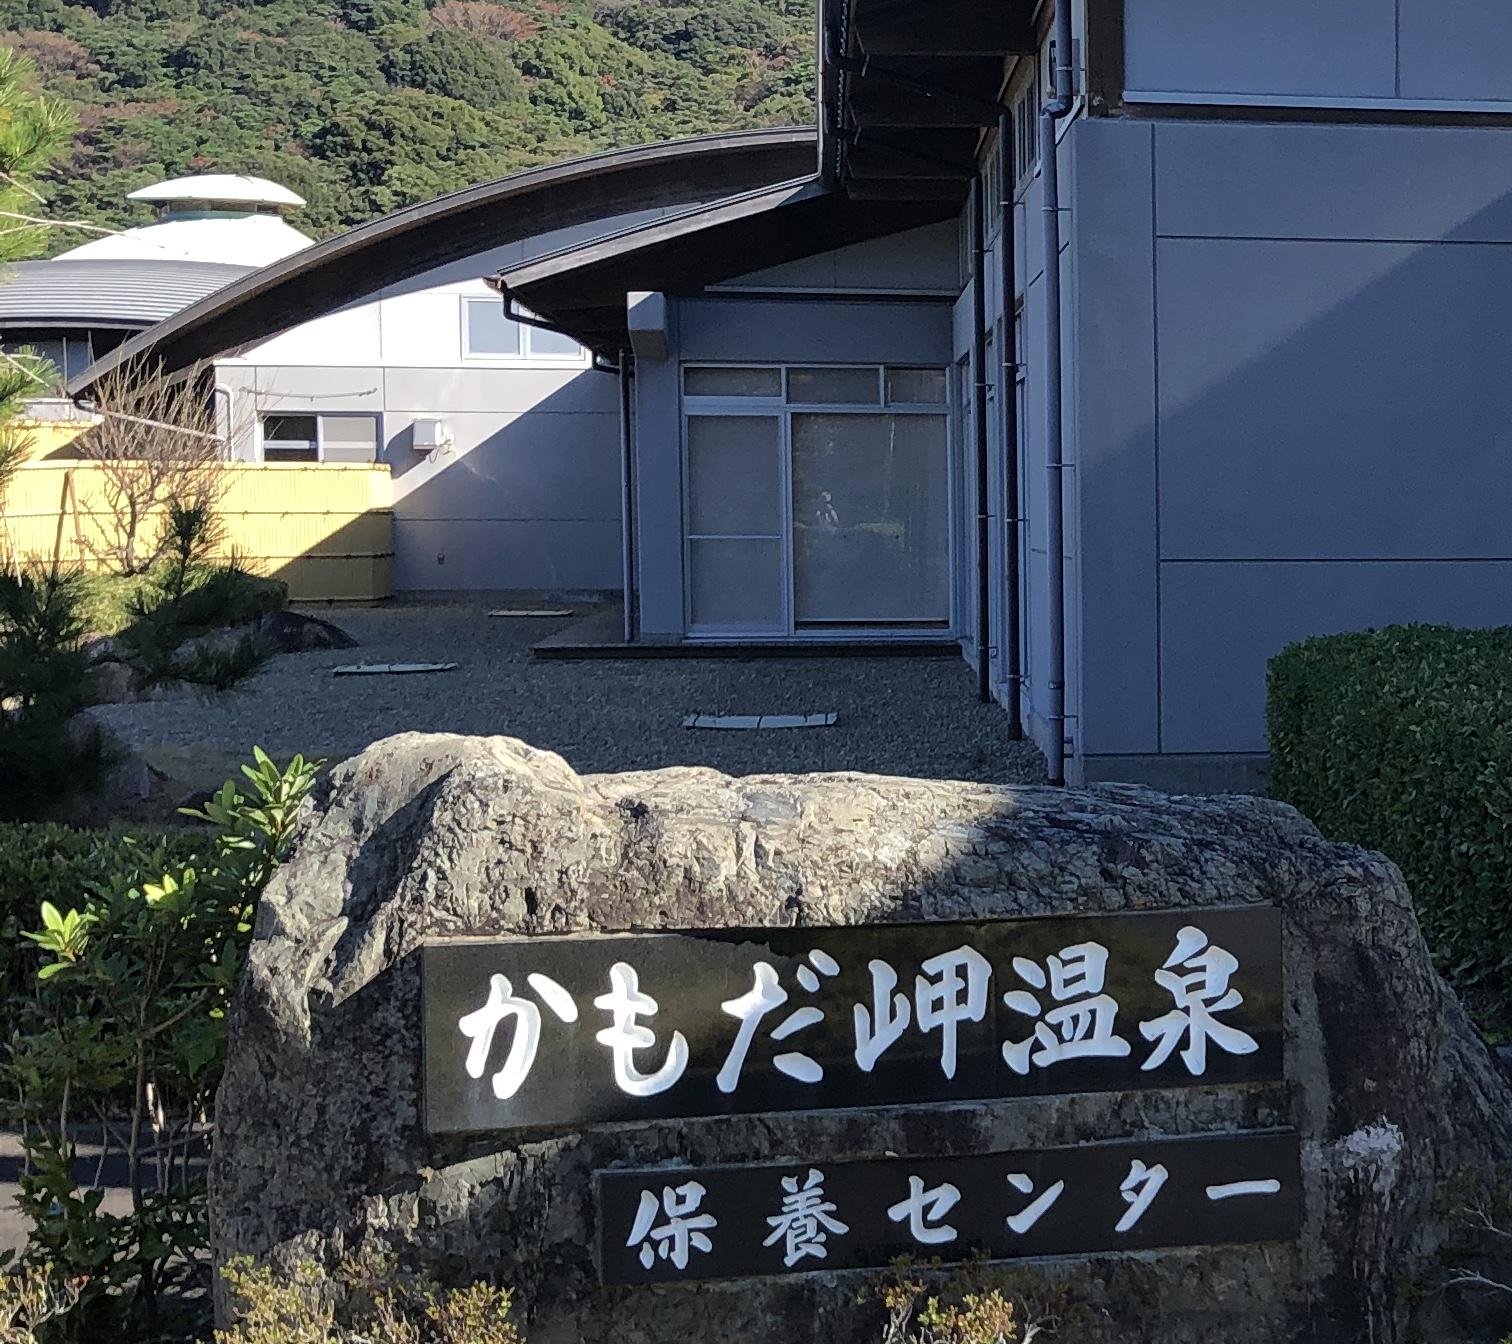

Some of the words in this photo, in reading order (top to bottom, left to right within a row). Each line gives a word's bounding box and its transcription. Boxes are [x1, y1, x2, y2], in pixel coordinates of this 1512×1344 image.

[458, 925, 1260, 1101] かもだ岬温泉
[625, 1157, 1282, 1269] 保養センター
